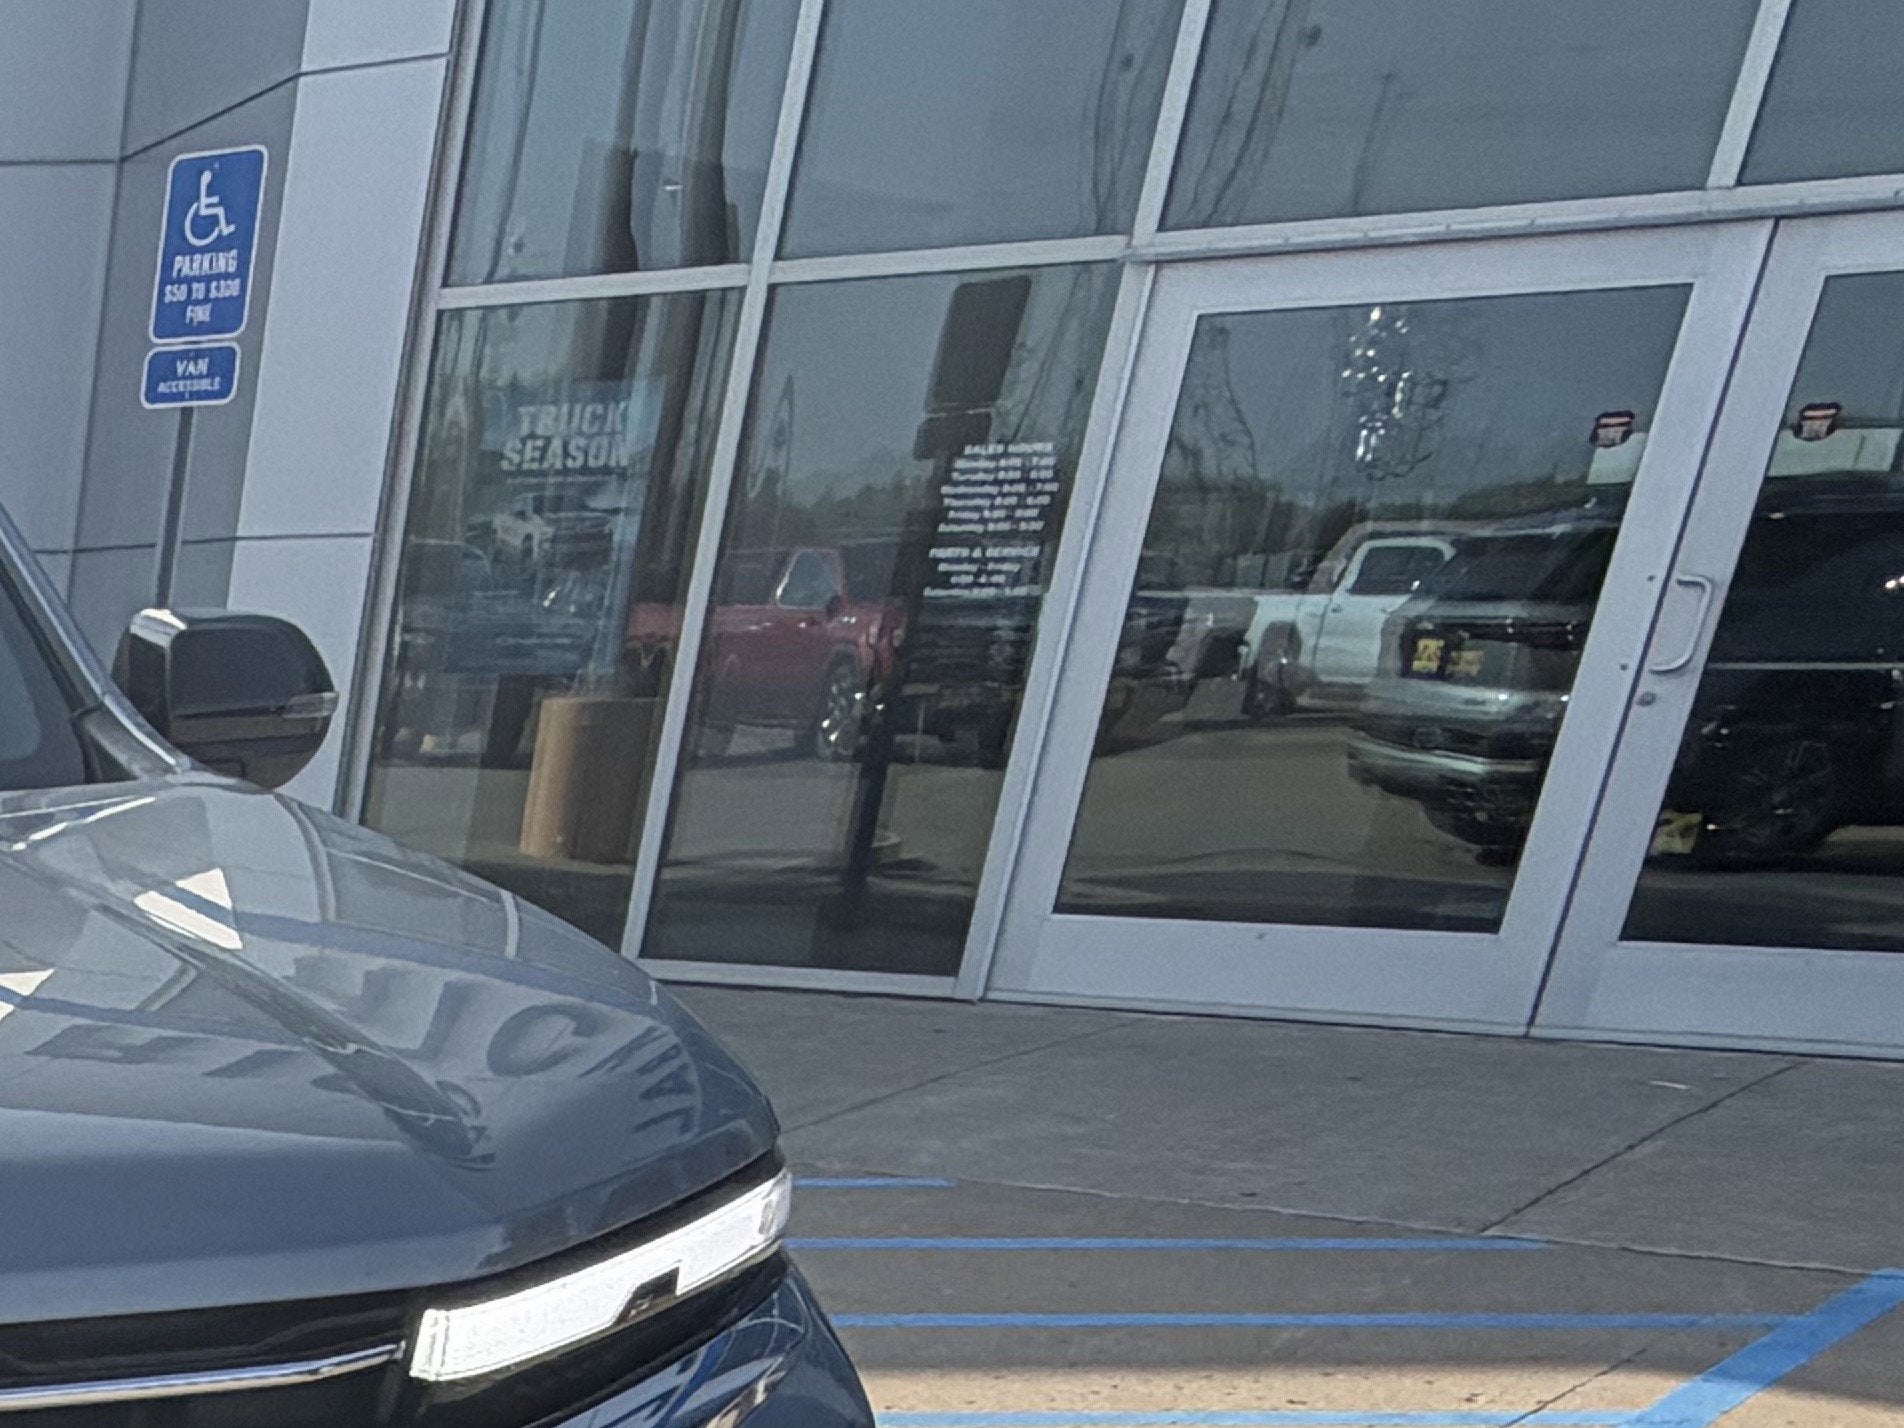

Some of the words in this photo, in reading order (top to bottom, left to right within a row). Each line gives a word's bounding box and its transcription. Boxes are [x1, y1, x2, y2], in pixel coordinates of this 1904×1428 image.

[172, 248, 238, 278] PARKING
[184, 302, 212, 325] FINE
[176, 357, 210, 377] VAN
[518, 402, 626, 436] TRUCK
[500, 434, 630, 471] SEASON
